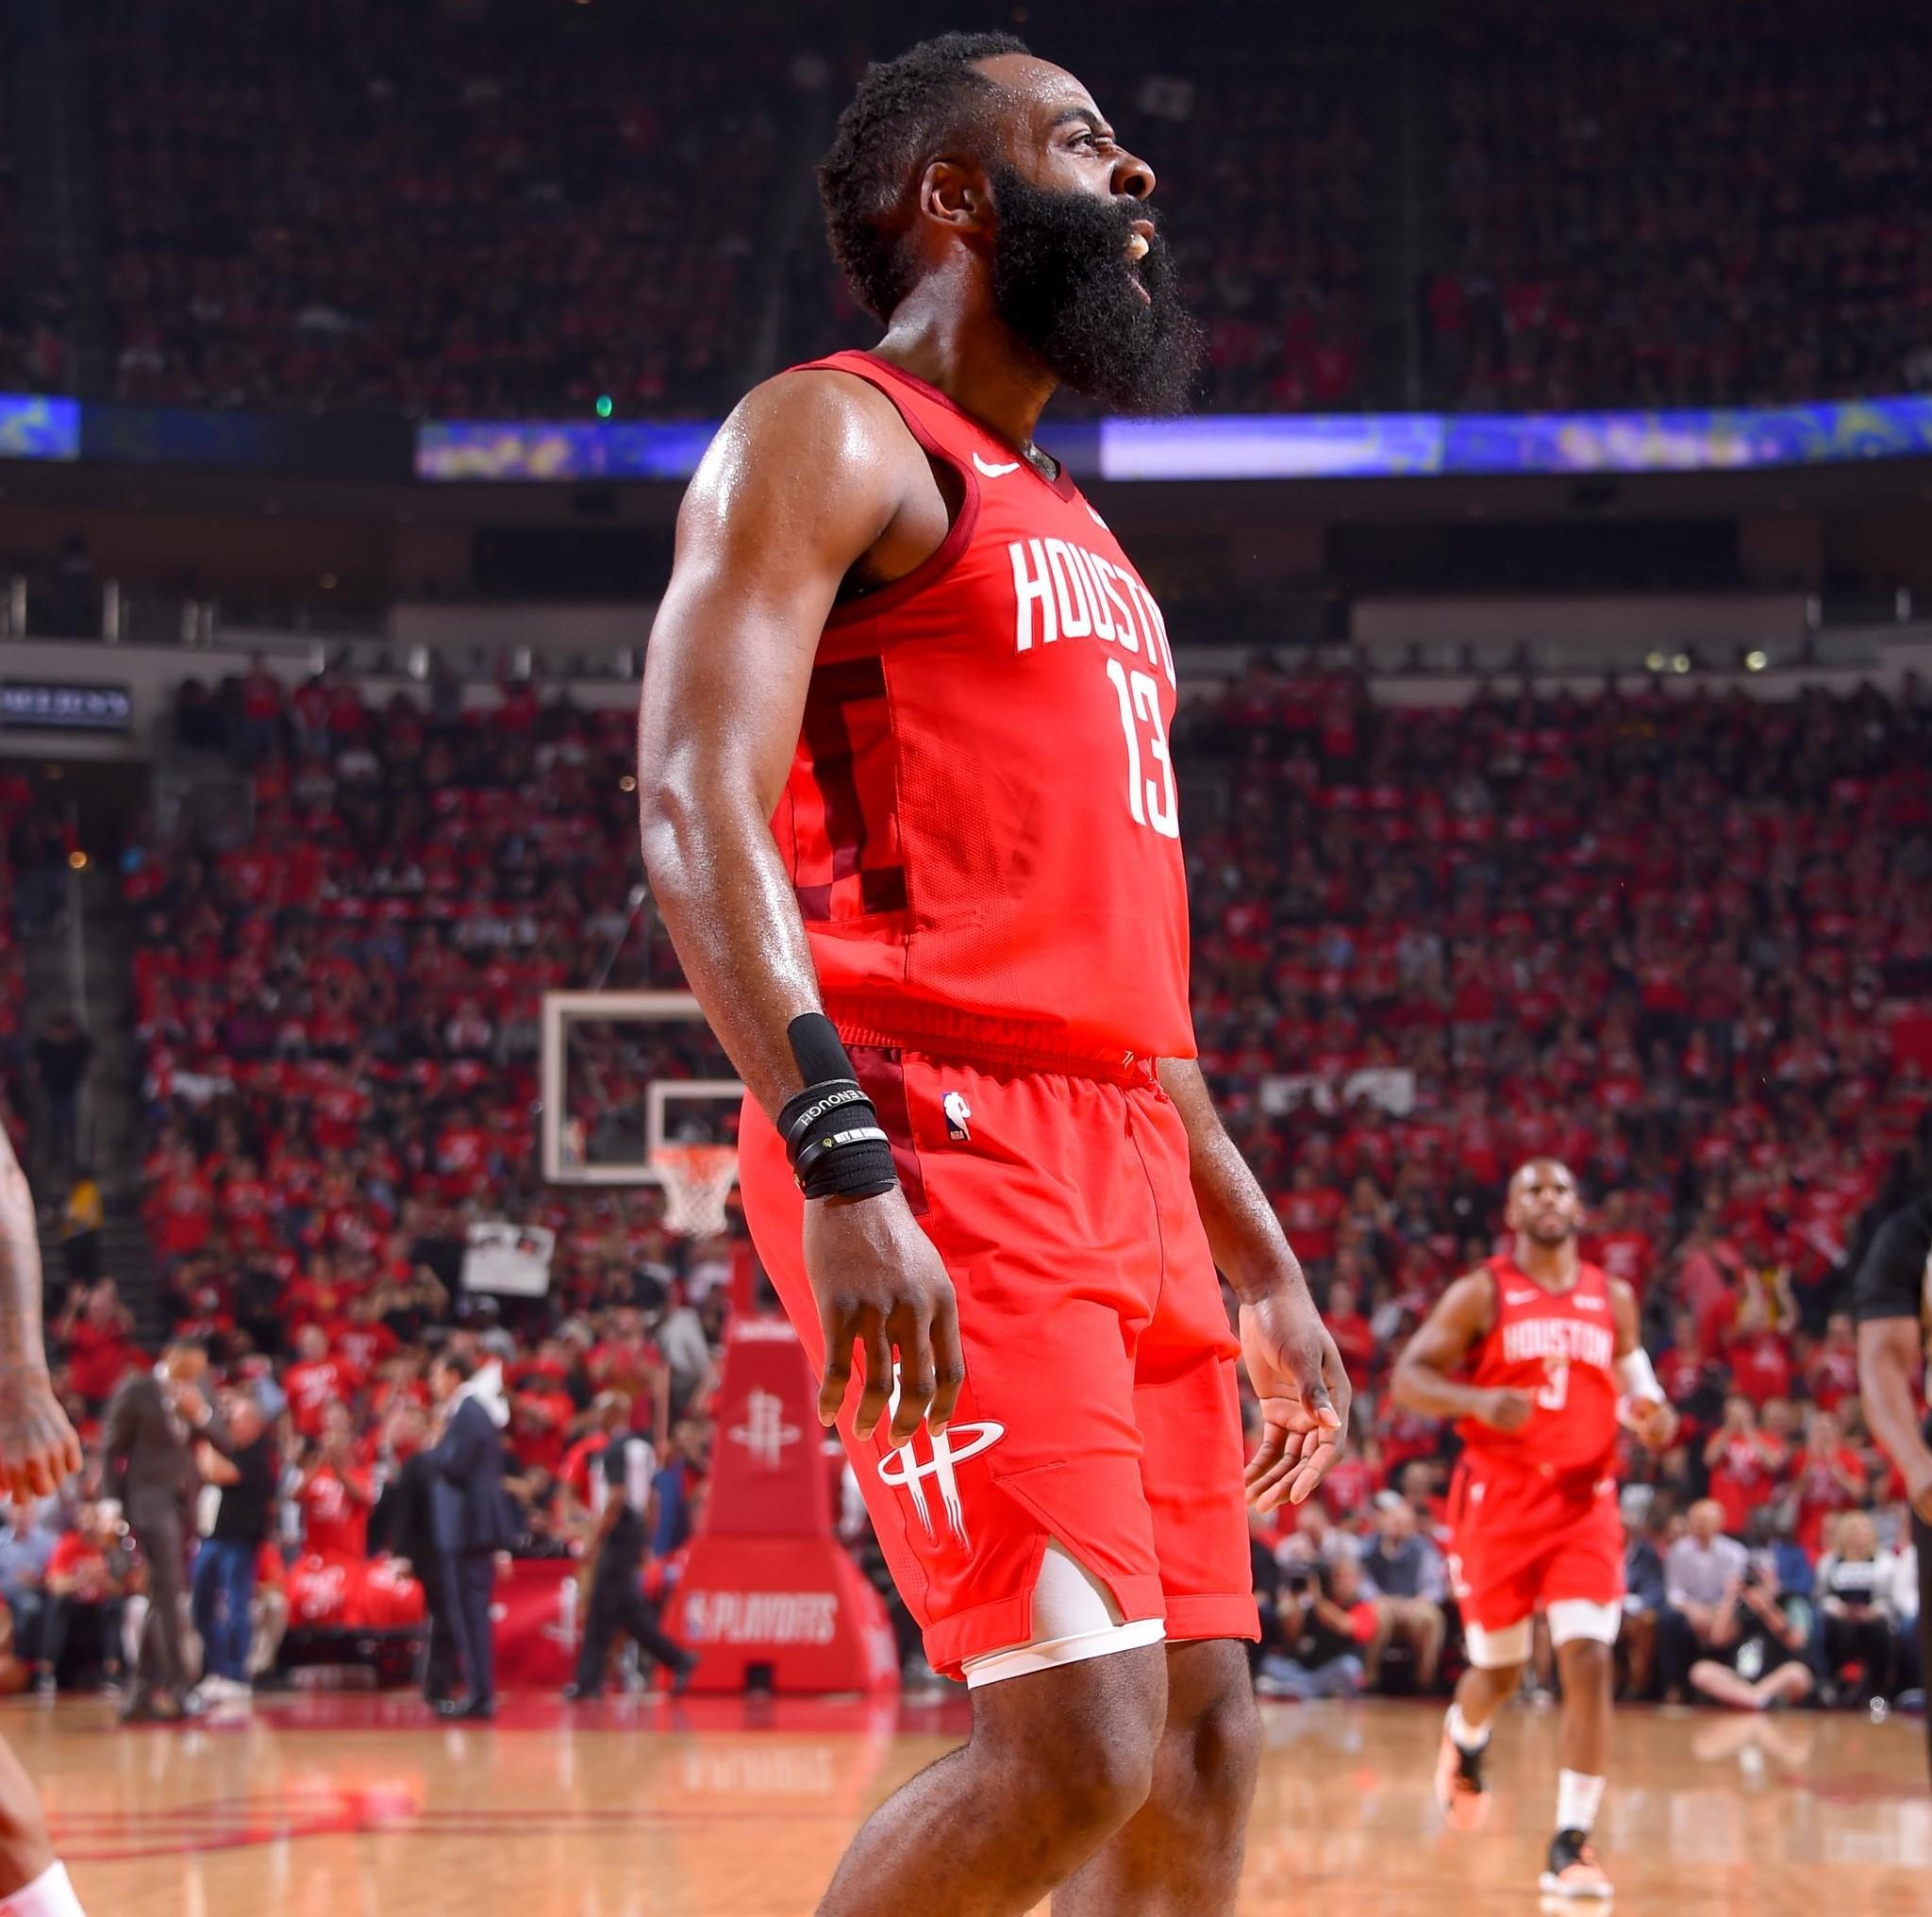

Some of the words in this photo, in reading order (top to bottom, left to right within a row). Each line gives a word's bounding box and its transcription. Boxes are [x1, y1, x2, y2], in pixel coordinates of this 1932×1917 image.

[1107, 657, 1179, 838] 13
[801, 1090, 859, 1126] ENOUGH
[950, 1130, 965, 1140] NBA
[1503, 1318, 1613, 1369] HOUSTON
[1538, 1356, 1571, 1411] 3
[711, 1592, 839, 1645] PLAYOFFS
